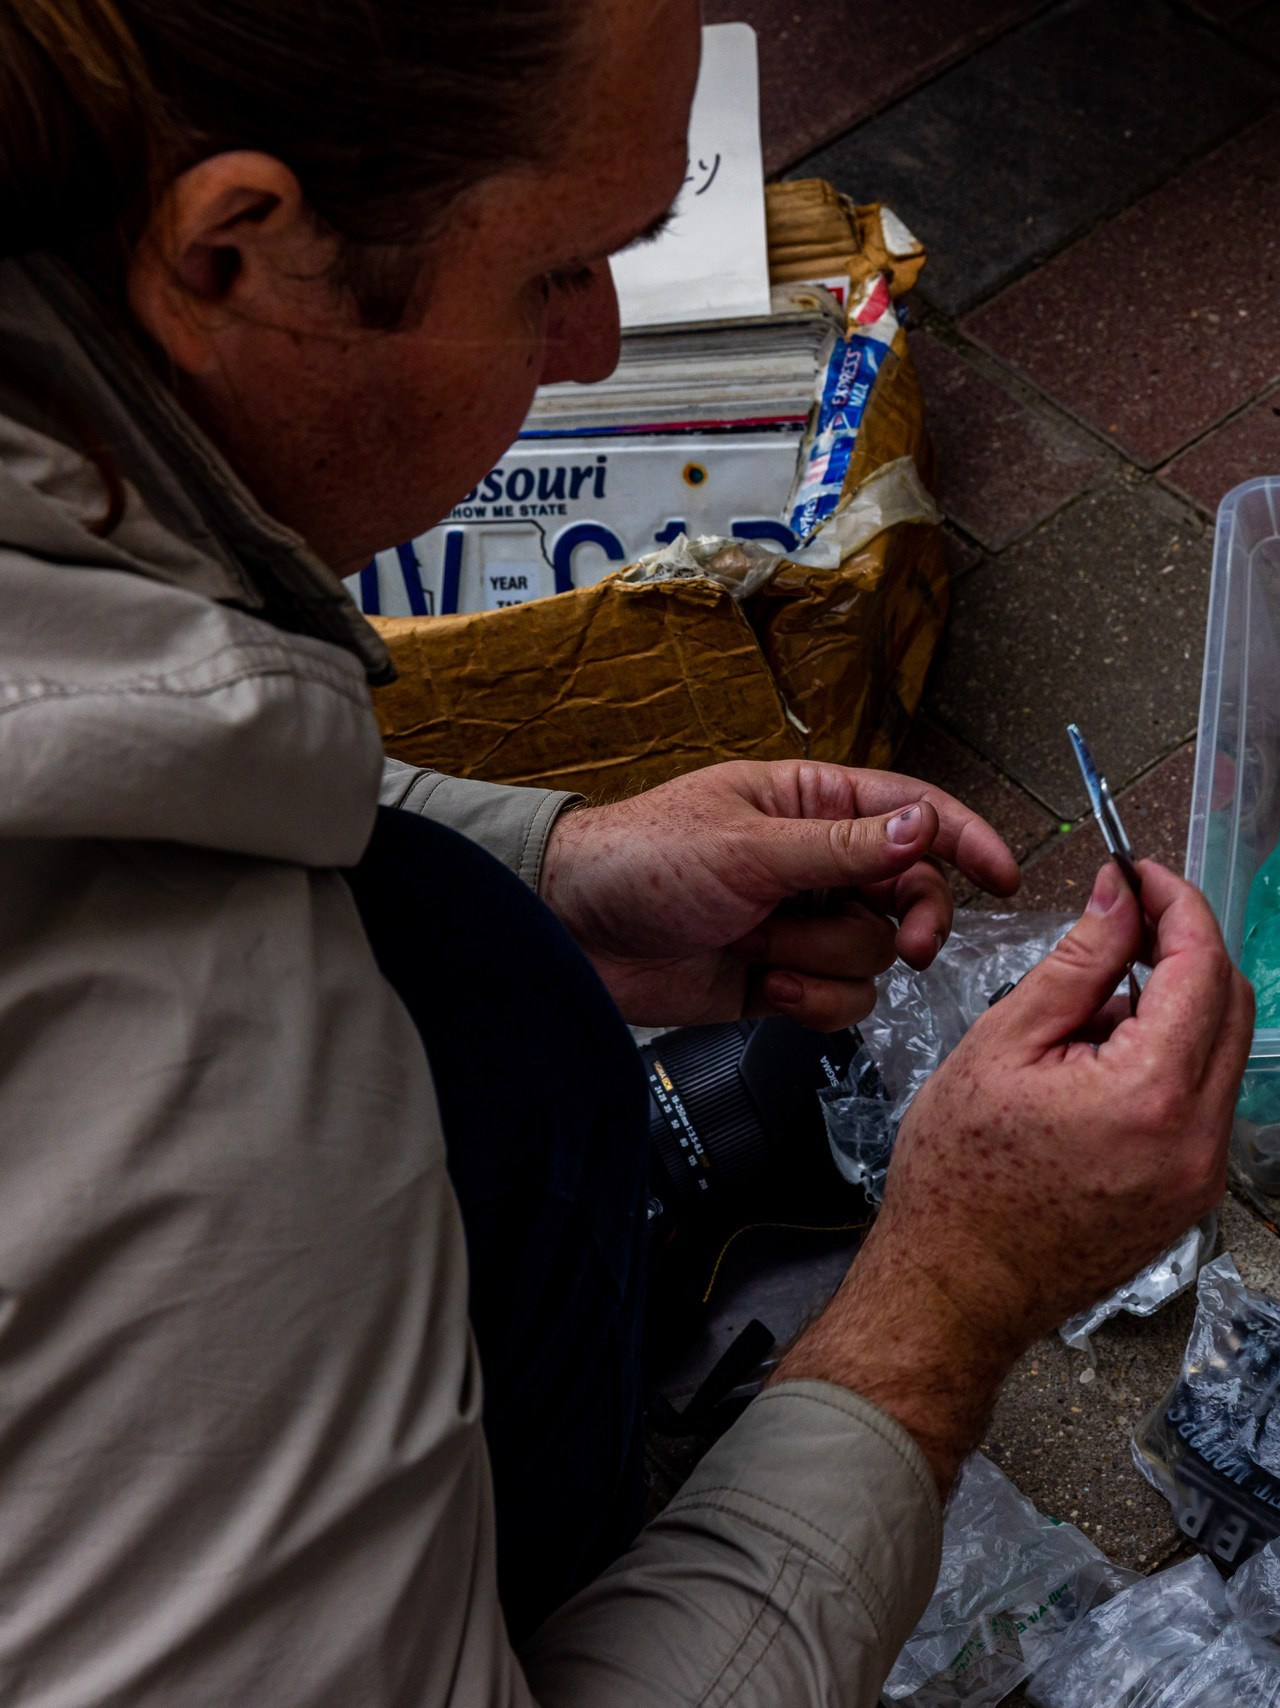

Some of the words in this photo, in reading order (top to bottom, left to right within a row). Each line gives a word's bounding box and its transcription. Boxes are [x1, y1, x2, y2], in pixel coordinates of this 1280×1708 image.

[832, 350, 862, 406] EXPRESS
[463, 455, 607, 503] souri
[492, 503, 514, 517] ME
[520, 502, 567, 516] STATE
[490, 575, 528, 591] YEAR
[820, 1055, 839, 1087] SIGMA
[663, 1103, 673, 1114] 35
[670, 1118, 681, 1130] 50
